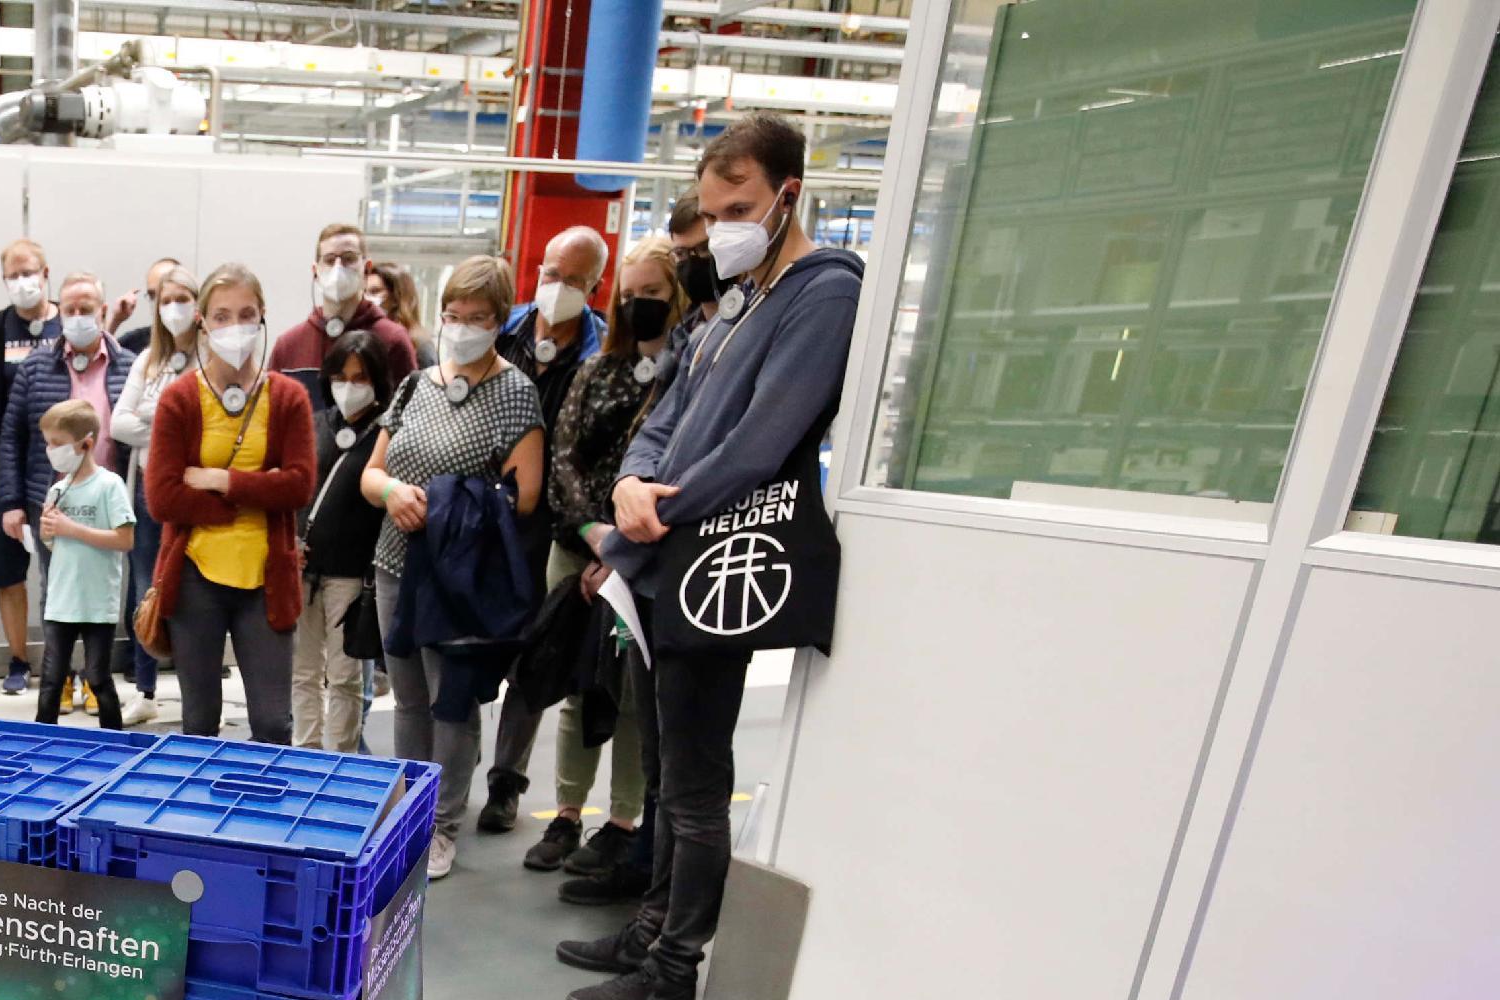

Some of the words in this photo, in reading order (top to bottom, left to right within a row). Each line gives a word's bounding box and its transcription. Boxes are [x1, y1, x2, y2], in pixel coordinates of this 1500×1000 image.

[721, 480, 799, 513] UBEN
[699, 501, 795, 536] HELDEN
[14, 893, 65, 915] Nacht
[72, 904, 102, 920] der
